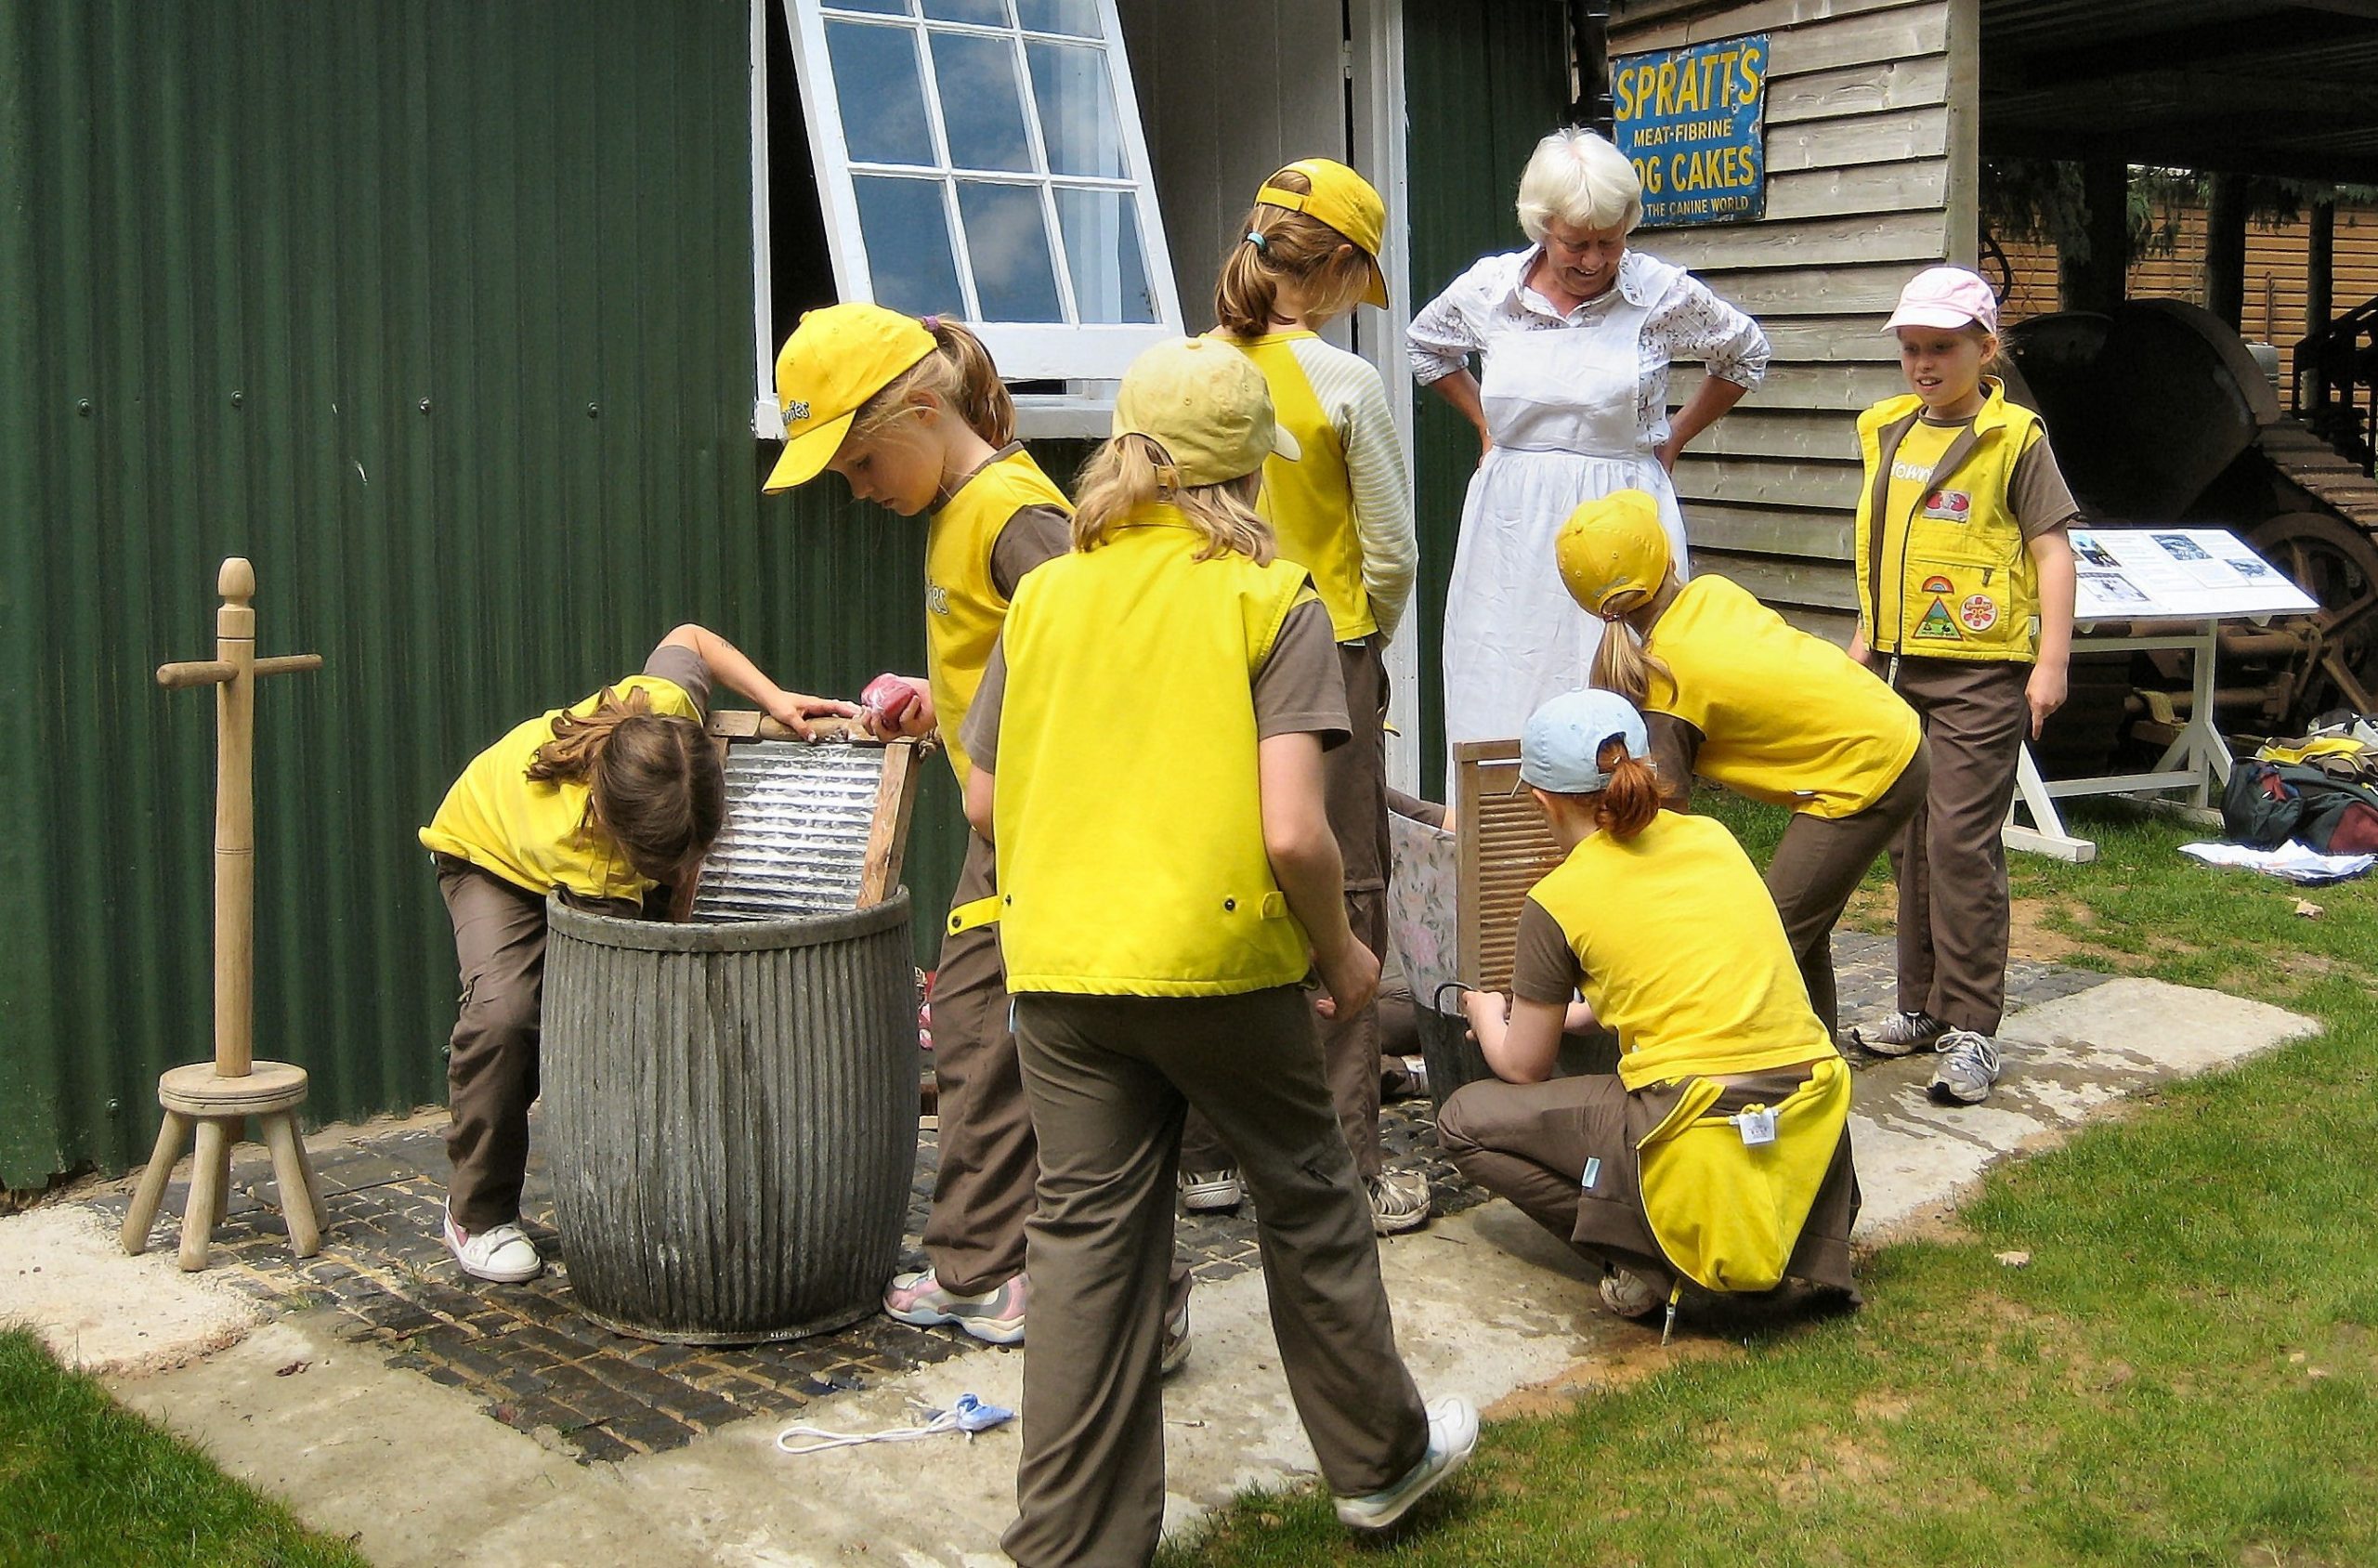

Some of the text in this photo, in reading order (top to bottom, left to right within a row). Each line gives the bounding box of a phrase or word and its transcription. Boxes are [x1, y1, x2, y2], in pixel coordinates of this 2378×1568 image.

[1614, 43, 1761, 122] SPRATT'S
[1633, 118, 1733, 148] MEAT-FIBRINE
[1632, 145, 1756, 194] OG CAKES
[1646, 195, 1749, 217] THE CANINE WORLD
